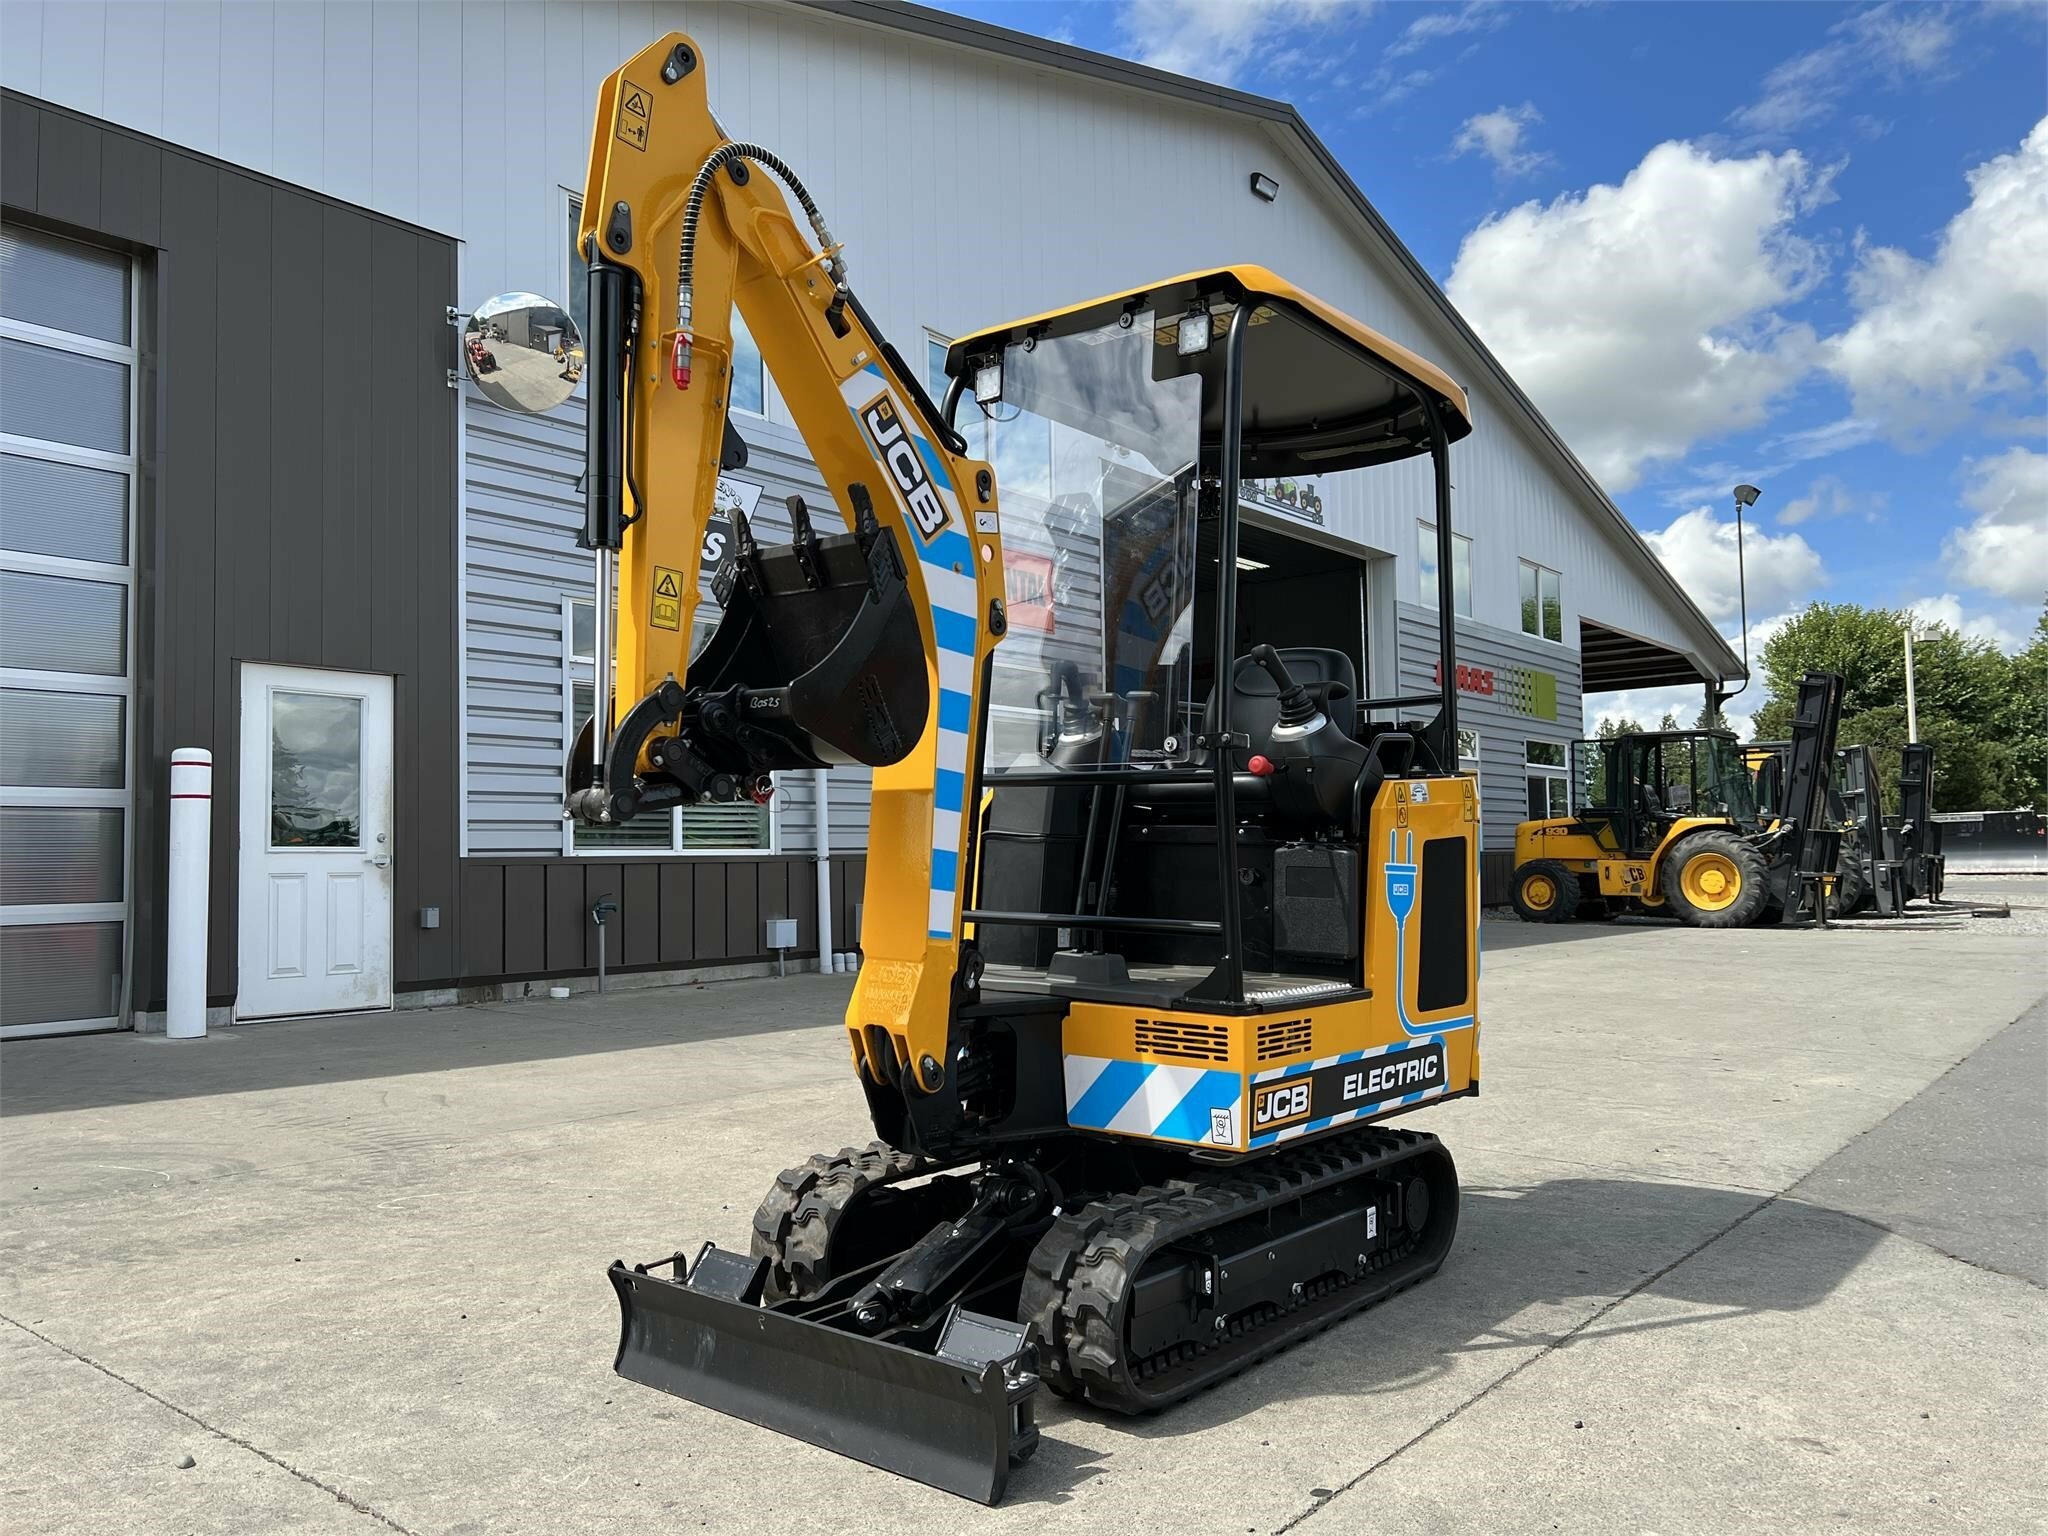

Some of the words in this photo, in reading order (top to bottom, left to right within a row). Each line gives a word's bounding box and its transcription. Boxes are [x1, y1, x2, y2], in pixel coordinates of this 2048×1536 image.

[867, 409, 944, 534] JCB
[1436, 660, 1494, 696] AAS
[1545, 827, 1568, 836] 930
[1394, 885, 1408, 894] JCB
[1258, 1085, 1308, 1123] JCB
[1344, 1055, 1437, 1100] ELECTRIC
